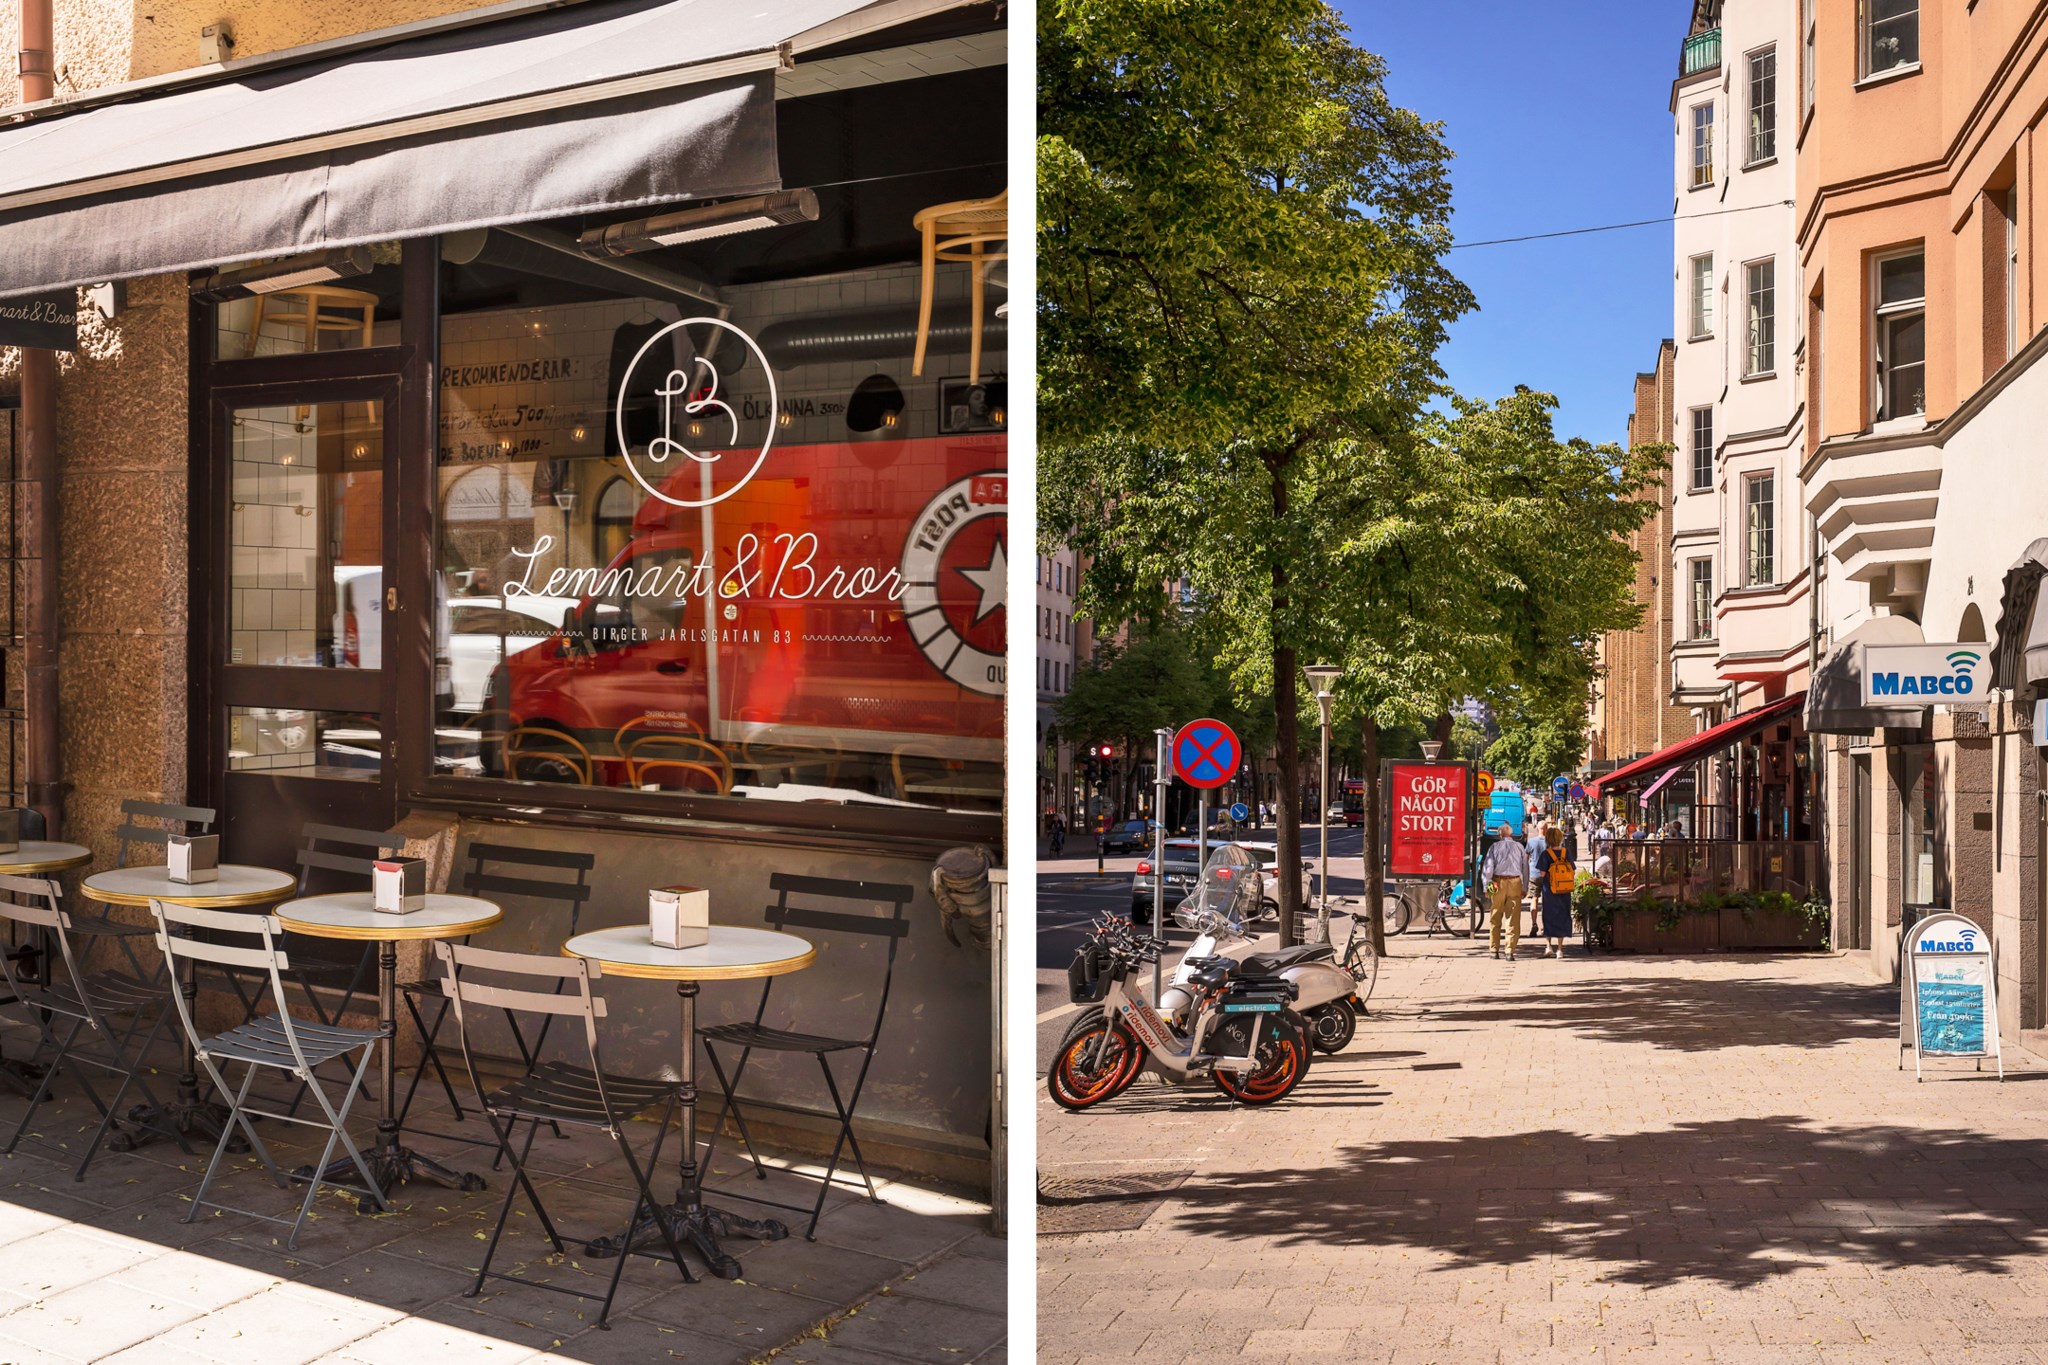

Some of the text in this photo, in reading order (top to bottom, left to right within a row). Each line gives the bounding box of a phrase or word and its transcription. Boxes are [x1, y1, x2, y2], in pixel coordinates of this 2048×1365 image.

[29, 301, 42, 321] &
[43, 302, 77, 325] Bror
[503, 532, 910, 600] Lennart & Bror
[592, 627, 791, 644] BIRGER JARLSGATAN 83
[1411, 776, 1447, 793] GÖR
[1400, 794, 1456, 812] NÅGOT
[1400, 815, 1455, 831] STORT
[1238, 1004, 1267, 1012] electric
[1126, 1011, 1159, 1050] ridemovi
[1140, 1004, 1172, 1043] ridemovi
